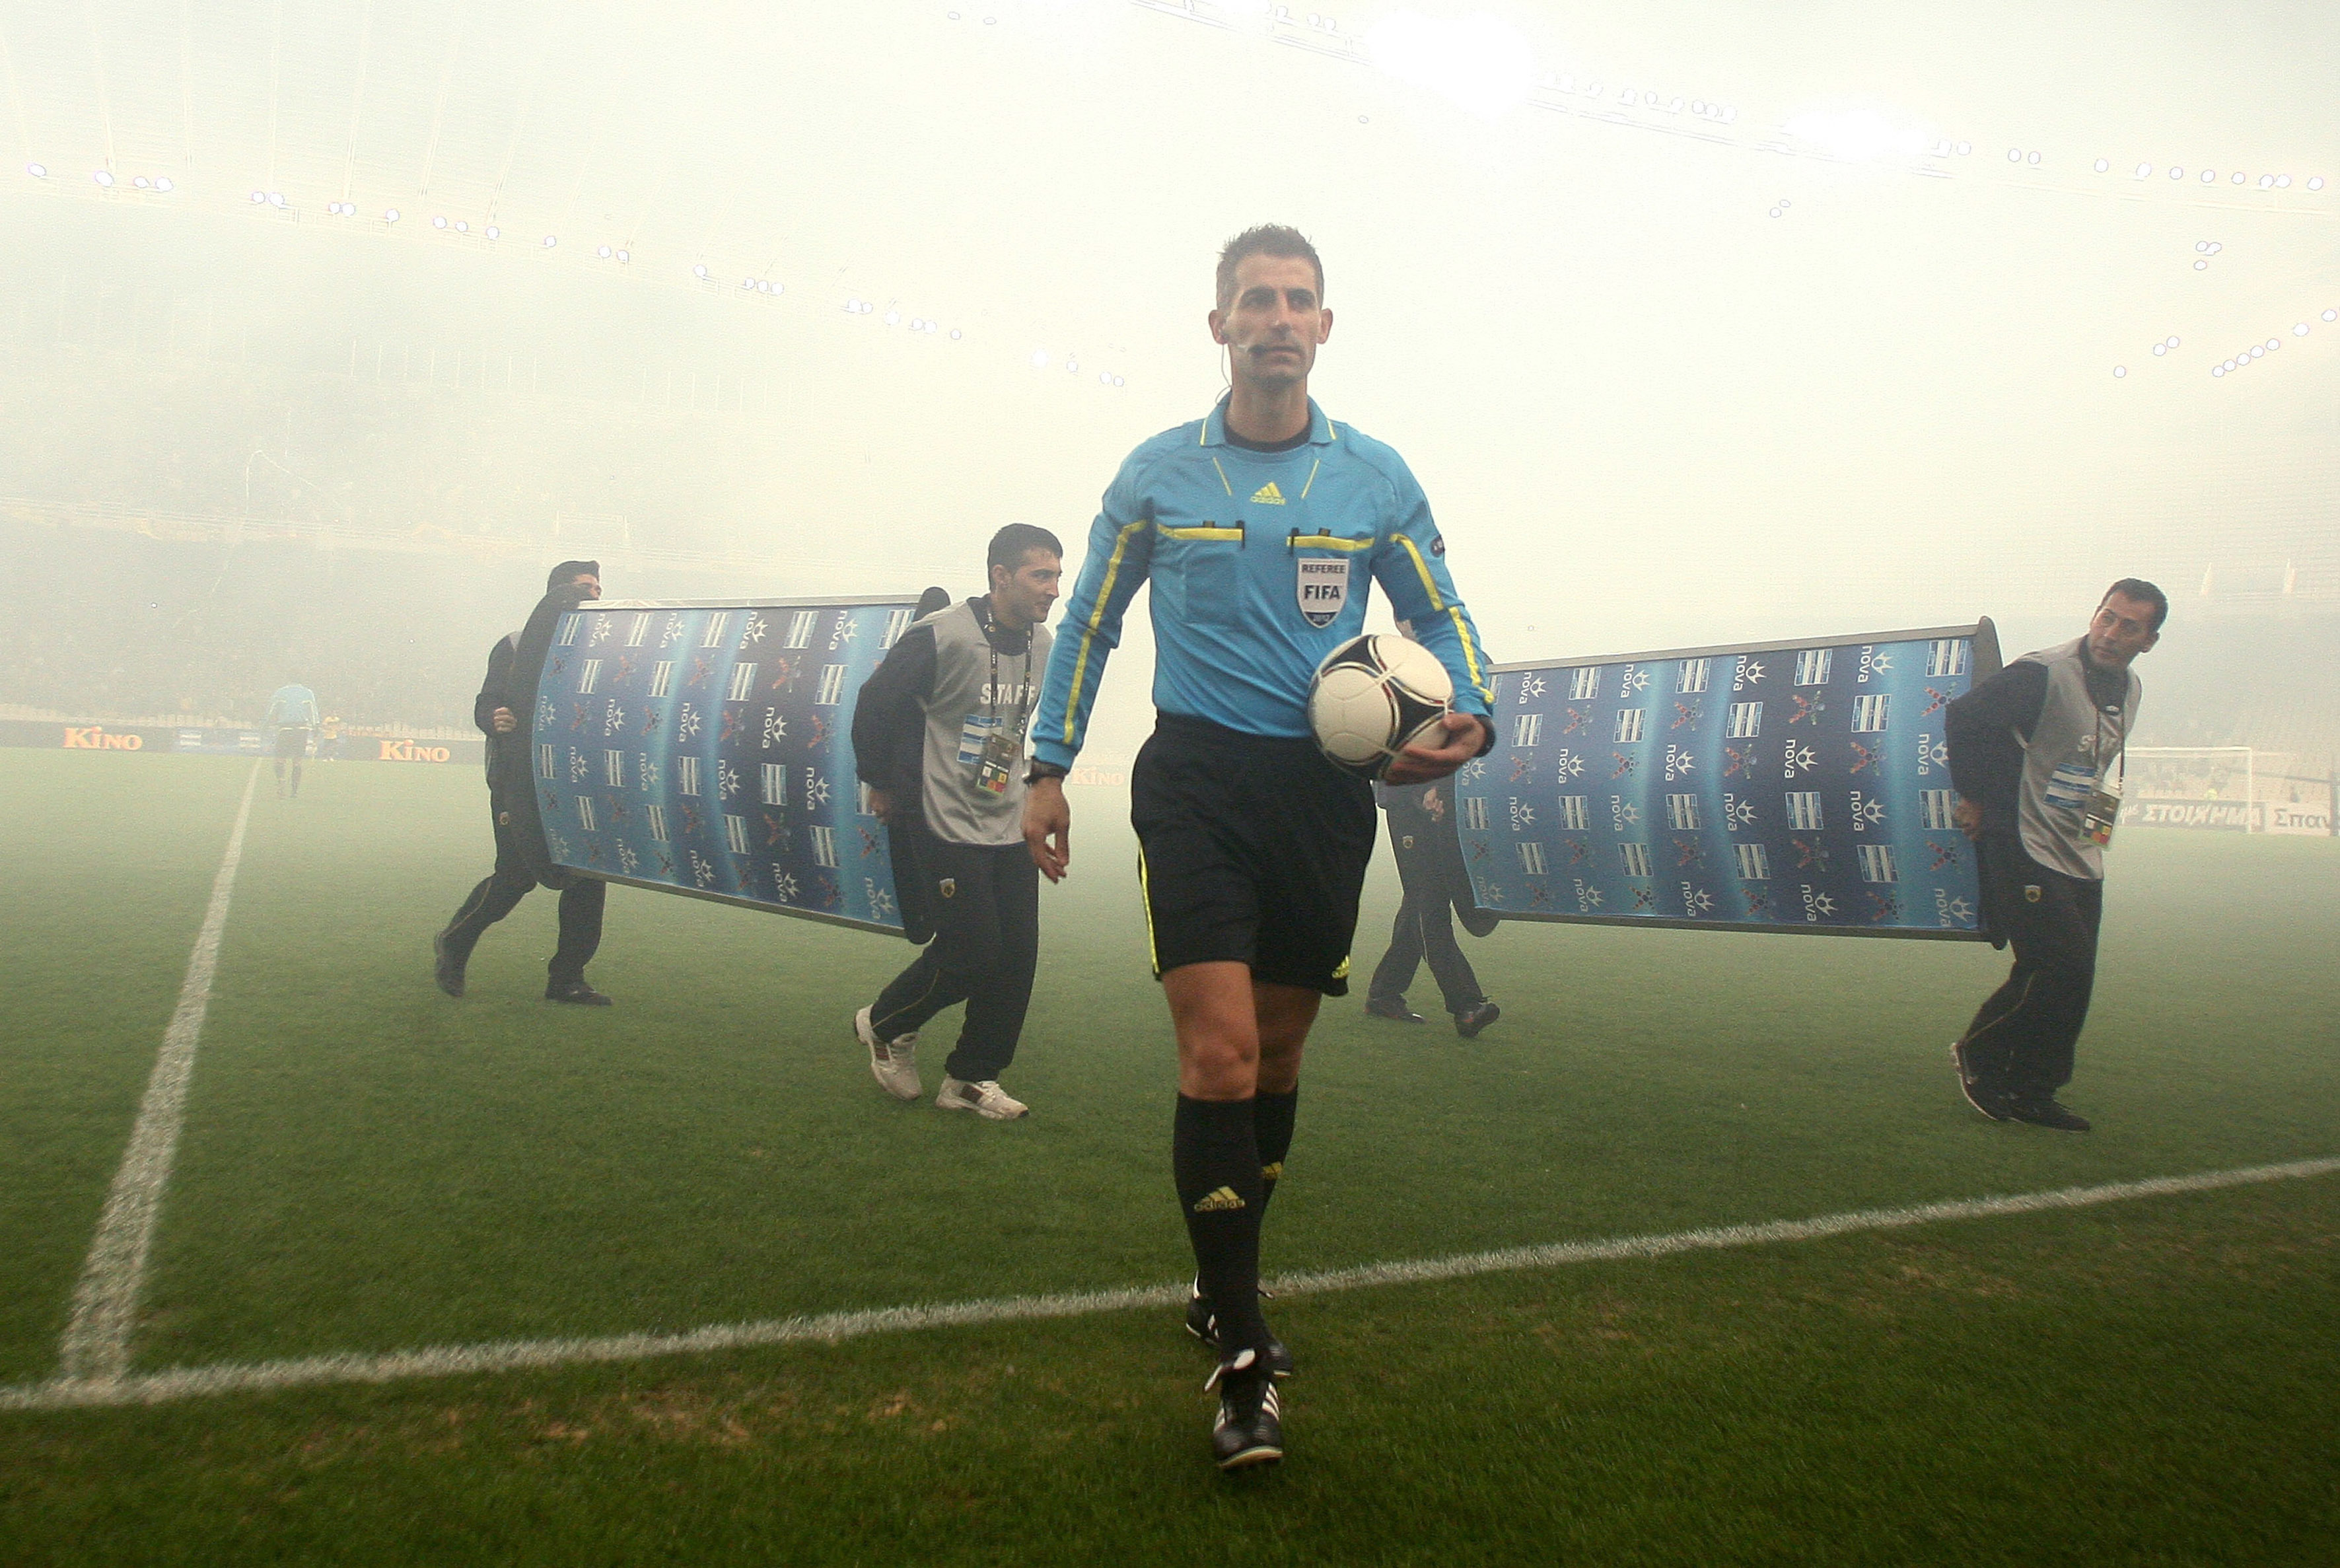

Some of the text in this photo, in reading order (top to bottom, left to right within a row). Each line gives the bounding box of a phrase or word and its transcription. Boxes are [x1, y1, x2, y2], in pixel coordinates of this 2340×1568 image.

[1301, 564, 1346, 573] REFEREE
[1304, 585, 1340, 600] FIFA
[739, 612, 758, 649] nova
[828, 610, 848, 651] nova
[1620, 664, 1635, 698] nova
[1733, 655, 1747, 692] nova
[1857, 645, 1872, 684] nova
[980, 683, 1036, 705] STAFF
[1519, 671, 1532, 705] nova
[604, 699, 616, 736] nova
[678, 702, 690, 742] nova
[762, 707, 775, 749] nova
[639, 752, 649, 791] nova
[1558, 748, 1569, 784] nova
[1665, 744, 1676, 781] nova
[1785, 739, 1796, 779] nova
[1918, 733, 1930, 775] nova
[718, 759, 727, 801] nova
[806, 767, 816, 810] nova
[1462, 762, 1470, 786] ova
[1509, 797, 1520, 831] nova
[1611, 795, 1623, 831] nova
[1723, 793, 1737, 831] nova
[1849, 791, 1864, 832] nova
[690, 849, 704, 888] nova
[772, 863, 787, 902] nova
[865, 877, 881, 919] nova
[1573, 878, 1588, 912] nova
[1681, 881, 1696, 917] nova
[1800, 884, 1816, 922] nova
[1934, 888, 1951, 927] nova
